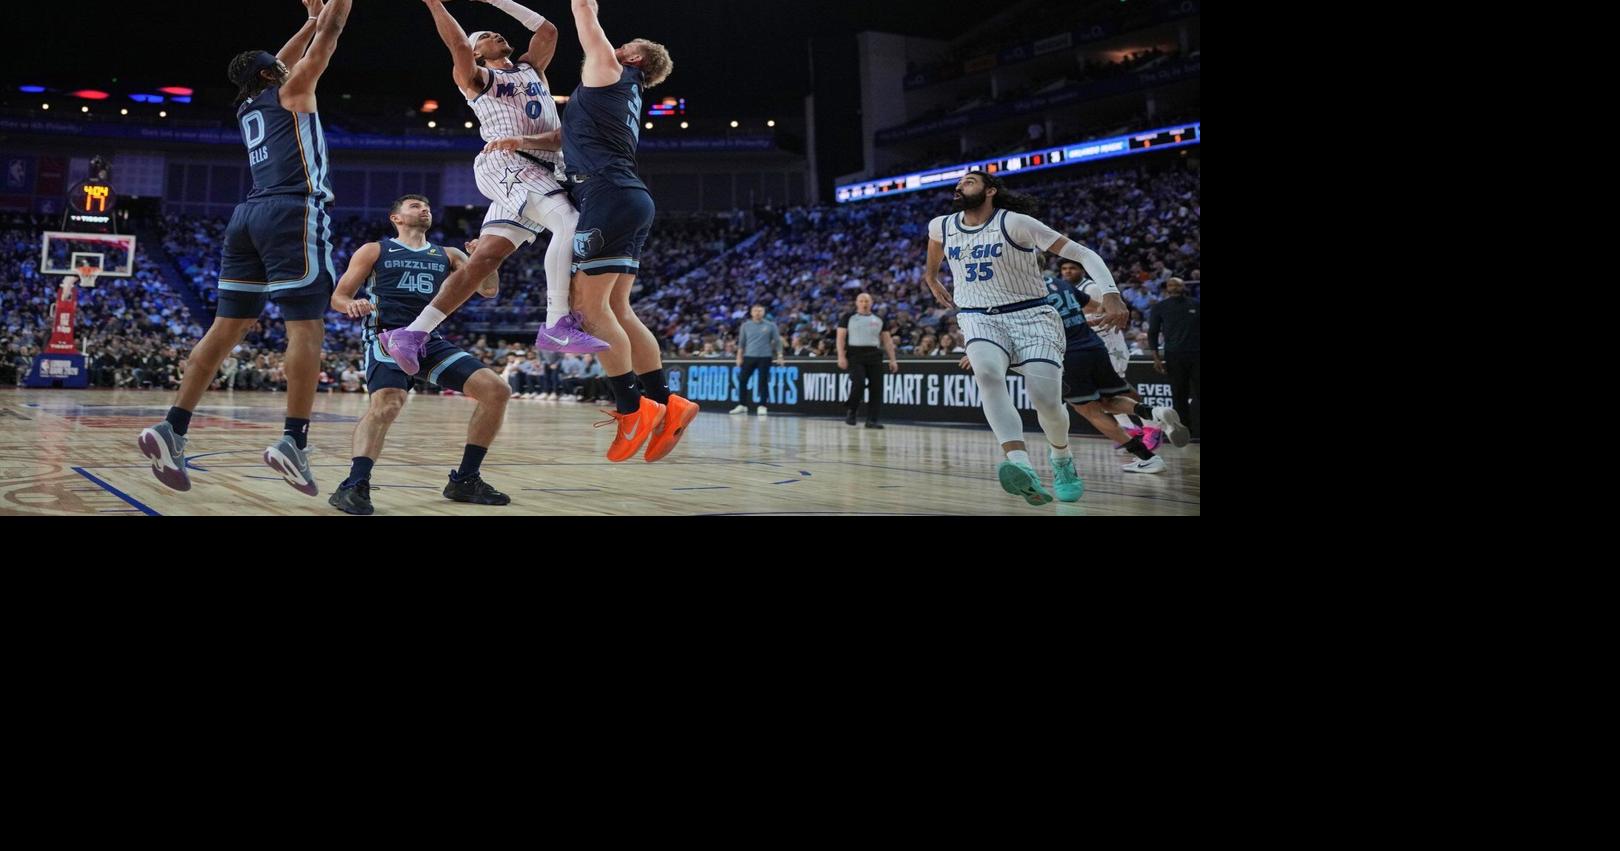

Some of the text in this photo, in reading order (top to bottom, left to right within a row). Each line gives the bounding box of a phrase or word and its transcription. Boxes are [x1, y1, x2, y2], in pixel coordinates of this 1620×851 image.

[525, 101, 542, 119] 0
[242, 110, 265, 149] 0
[948, 243, 1003, 260] MAGIC
[384, 260, 446, 273] GRIZZLIES
[965, 262, 994, 282] 35
[396, 271, 434, 294] 46
[687, 365, 729, 402] GOOD
[803, 373, 835, 402] WITH
[883, 374, 924, 405] HART
[927, 375, 940, 406] &
[1137, 383, 1173, 397] EVER
